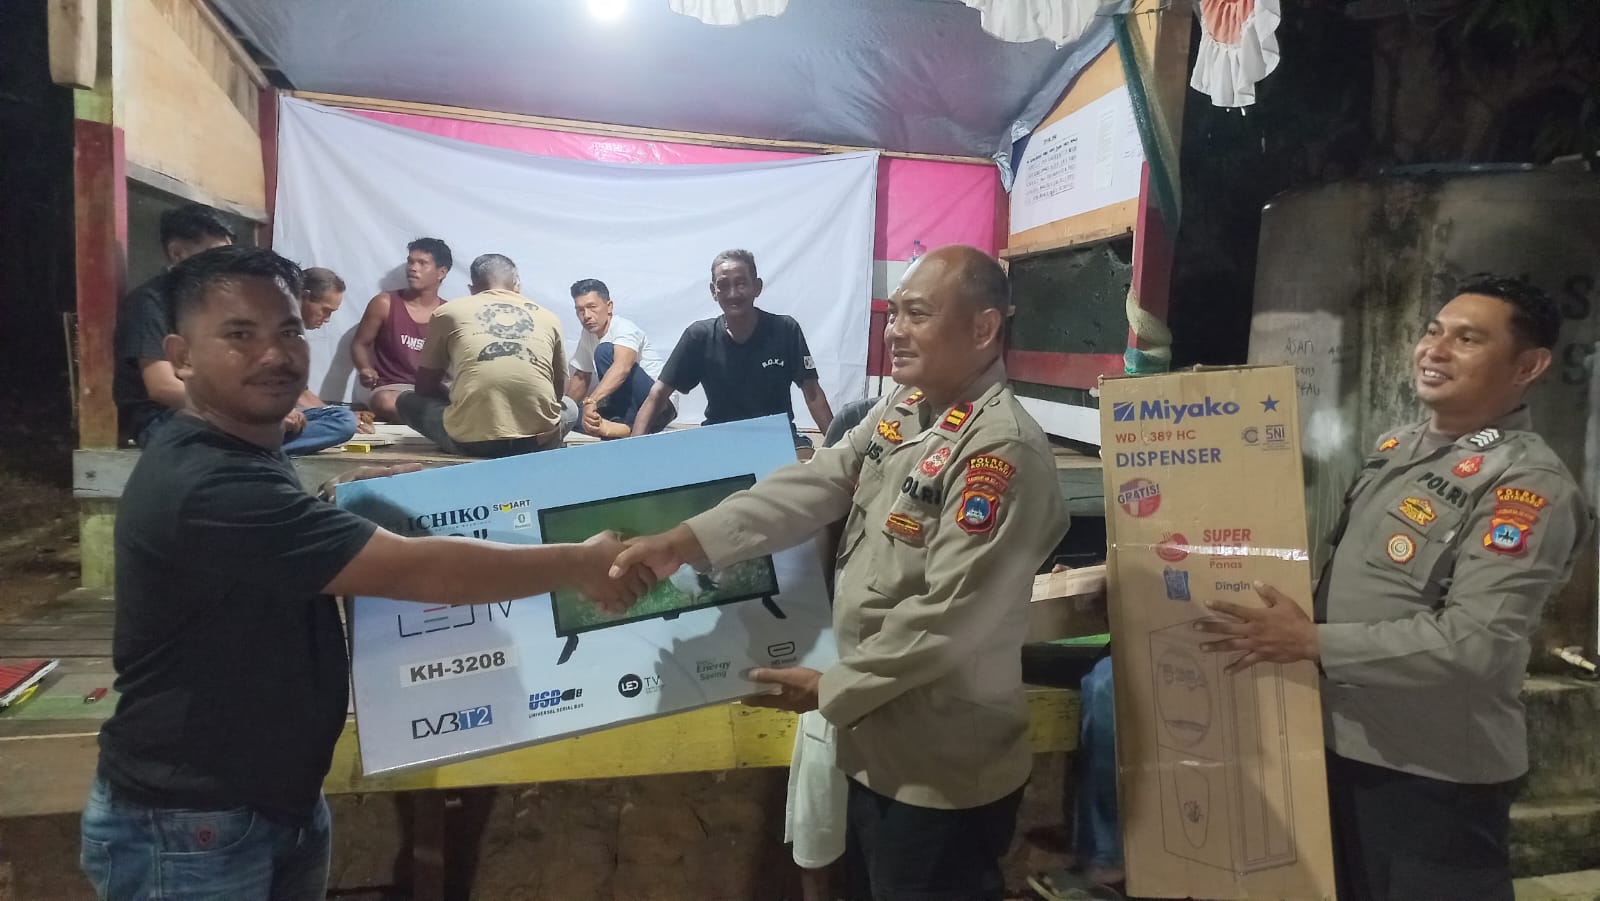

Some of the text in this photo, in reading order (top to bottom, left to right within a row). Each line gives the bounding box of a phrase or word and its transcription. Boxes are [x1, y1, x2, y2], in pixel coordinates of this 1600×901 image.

[1139, 396, 1240, 424] Miyako
[1115, 432, 1137, 444] WD
[1176, 429, 1197, 441] HC
[1265, 427, 1285, 440] SNI
[1116, 447, 1222, 468] DISPENSER
[1117, 483, 1161, 505] GRATIS!
[1417, 472, 1469, 508] POLRI
[1203, 528, 1252, 543] SUPER
[1209, 560, 1243, 569] Panas
[1215, 581, 1251, 593] Dingin
[410, 651, 506, 683] KH-3208
[696, 660, 731, 674] Energy
[621, 679, 640, 691] LED
[644, 674, 661, 688] TV
[699, 670, 727, 681] Saving
[528, 689, 561, 710] USB
[528, 709, 556, 719] UNIVERSAL
[556, 705, 574, 714] SERIAL
